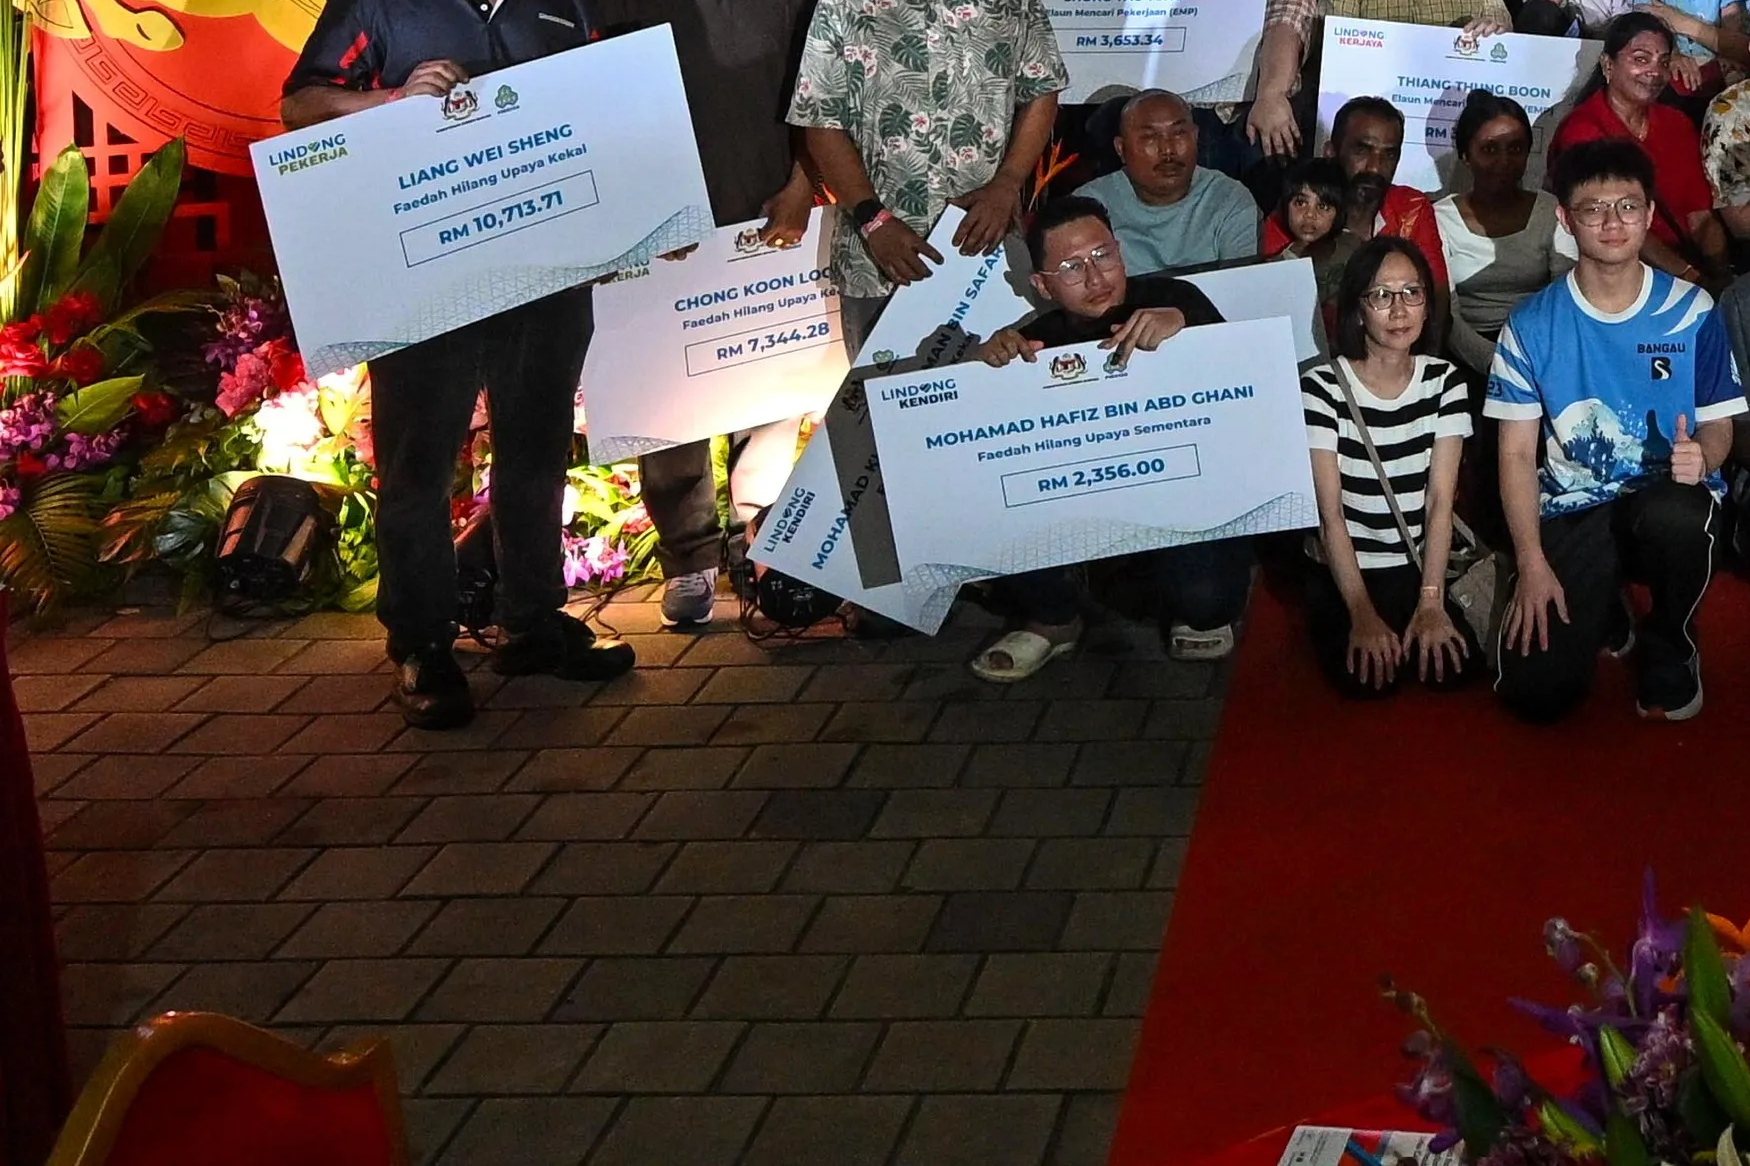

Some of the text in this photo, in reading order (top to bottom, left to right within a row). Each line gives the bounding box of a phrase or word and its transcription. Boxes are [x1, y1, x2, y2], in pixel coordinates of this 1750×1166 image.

[1075, 7, 1198, 19] Mencari Pekerjaan (EMP)
[1076, 34, 1163, 48] RM 3,653.34
[1339, 38, 1383, 48] KERJAYA
[1392, 94, 1421, 104] Elaun
[1397, 76, 1452, 91] THIANG
[1508, 86, 1551, 99] BOON
[1425, 126, 1447, 139] RM
[278, 147, 348, 176] PEKERJA
[398, 160, 459, 190] LIANG
[464, 146, 504, 169] WEI
[508, 123, 573, 155] SHENG
[393, 144, 587, 215] Faedah Hilang Upaya Kekal
[439, 190, 563, 245] RM 10,713.71
[674, 287, 739, 312] CHONG
[743, 275, 795, 296] KOON
[682, 312, 730, 331] Faedah
[734, 300, 775, 319] Hilang
[778, 291, 817, 309] Upaya
[717, 321, 830, 361] RM 7,344.28
[1637, 342, 1686, 354] BANGAU
[899, 391, 958, 410] KENDIRI
[925, 384, 1254, 450] MOHAMAD HAFIZ BIN ABD GHANI
[811, 475, 869, 569] MOHAMAD
[947, 301, 970, 331] BIN
[977, 415, 1211, 462] Faedah Hilang Upaya Sementara
[1038, 457, 1166, 493] RM 2,356.00
[782, 491, 815, 543] KENDIRI
